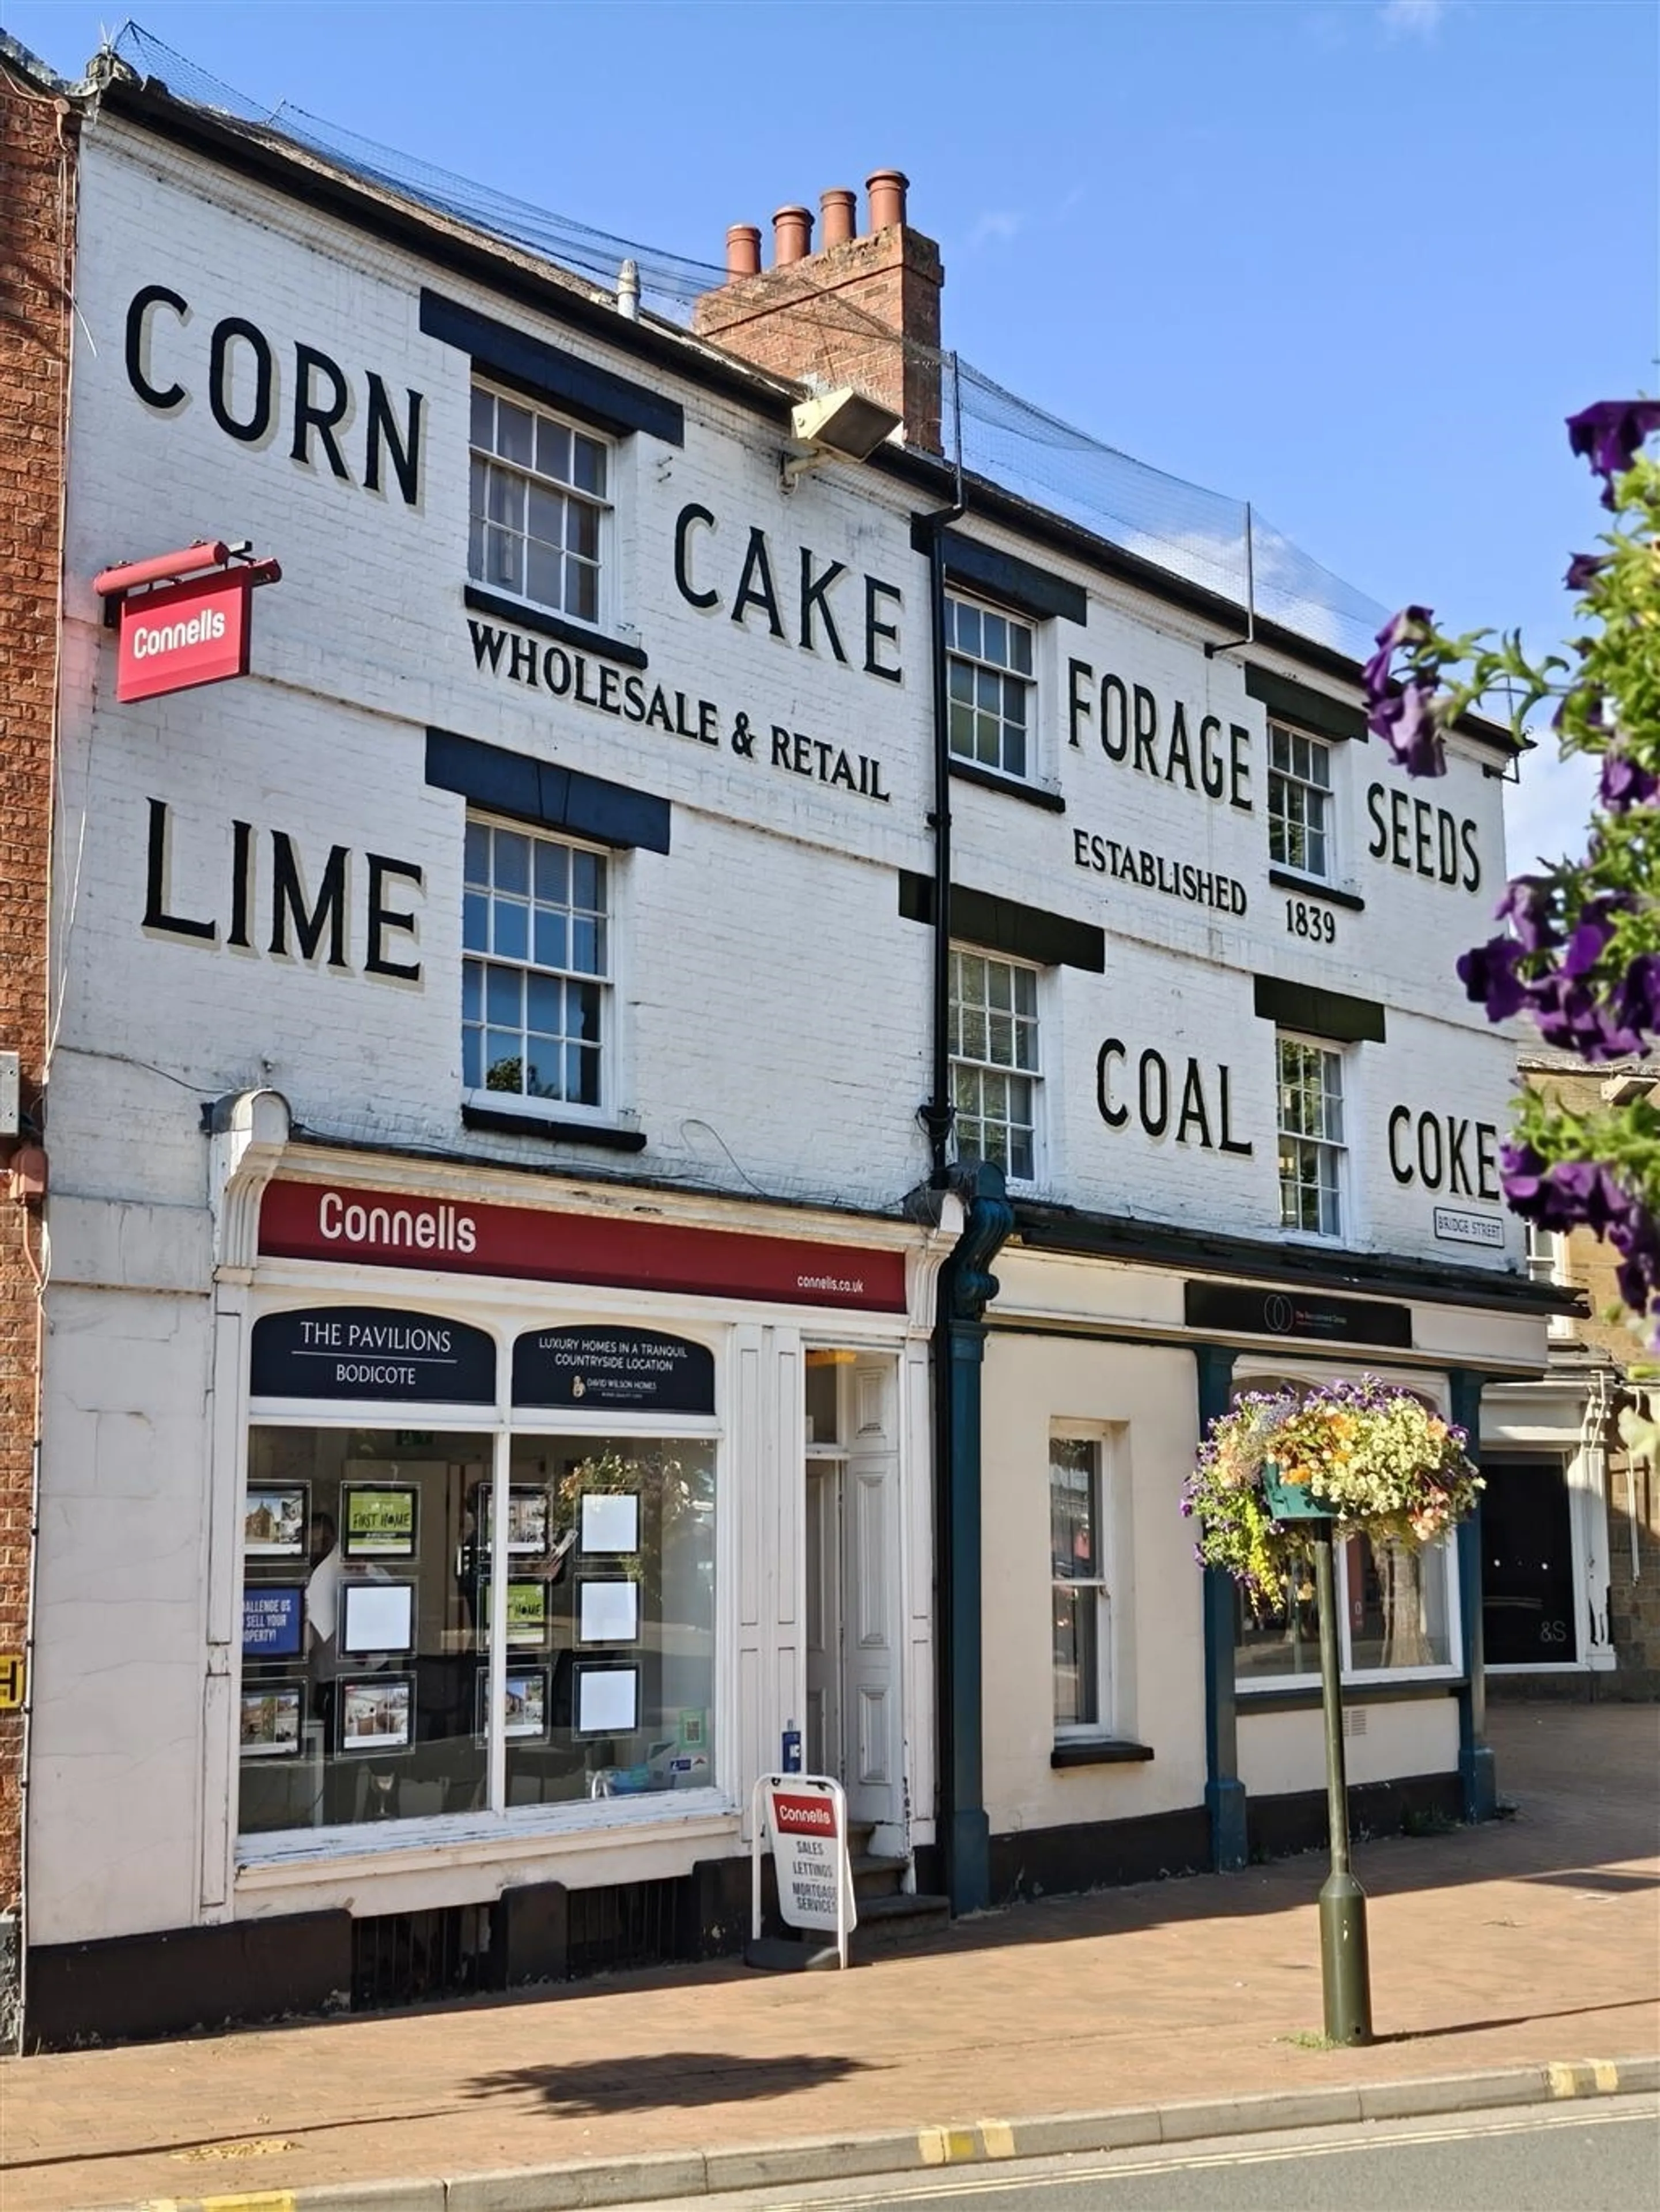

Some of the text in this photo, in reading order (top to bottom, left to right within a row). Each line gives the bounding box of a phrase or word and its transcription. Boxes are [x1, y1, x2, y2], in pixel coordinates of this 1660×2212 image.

[126, 285, 425, 507] CORN
[674, 502, 902, 683] CAKE
[133, 608, 225, 660] Connells
[467, 619, 891, 802] WHOLESALE & RETAIL
[1068, 657, 1253, 811] FORAGE
[1367, 782, 1480, 892] SEEDS
[142, 796, 423, 982] LIME
[1073, 828, 1247, 917] ESTABLISHED
[1285, 899, 1336, 944] 1839
[1096, 1038, 1253, 1156] COAL
[1388, 1104, 1500, 1200] COKE
[319, 1191, 478, 1254] Connells
[1438, 1215, 1500, 1240] BRIDGE STREET
[797, 1275, 864, 1292] connells.co.uk
[300, 1321, 452, 1353] THE PAVILIONS
[539, 1337, 688, 1358] LUXURY HOMES IN A TRANQUIL
[335, 1364, 417, 1385] BODICOTE
[555, 1353, 674, 1371] COUNTRYSIDE LOCATION
[243, 1600, 279, 1613] ALLENGE
[243, 1628, 277, 1643] OPERTY!
[780, 1805, 831, 1825] Connells
[792, 1862, 833, 1878] LETTINGS
[796, 1840, 824, 1855] SALES
